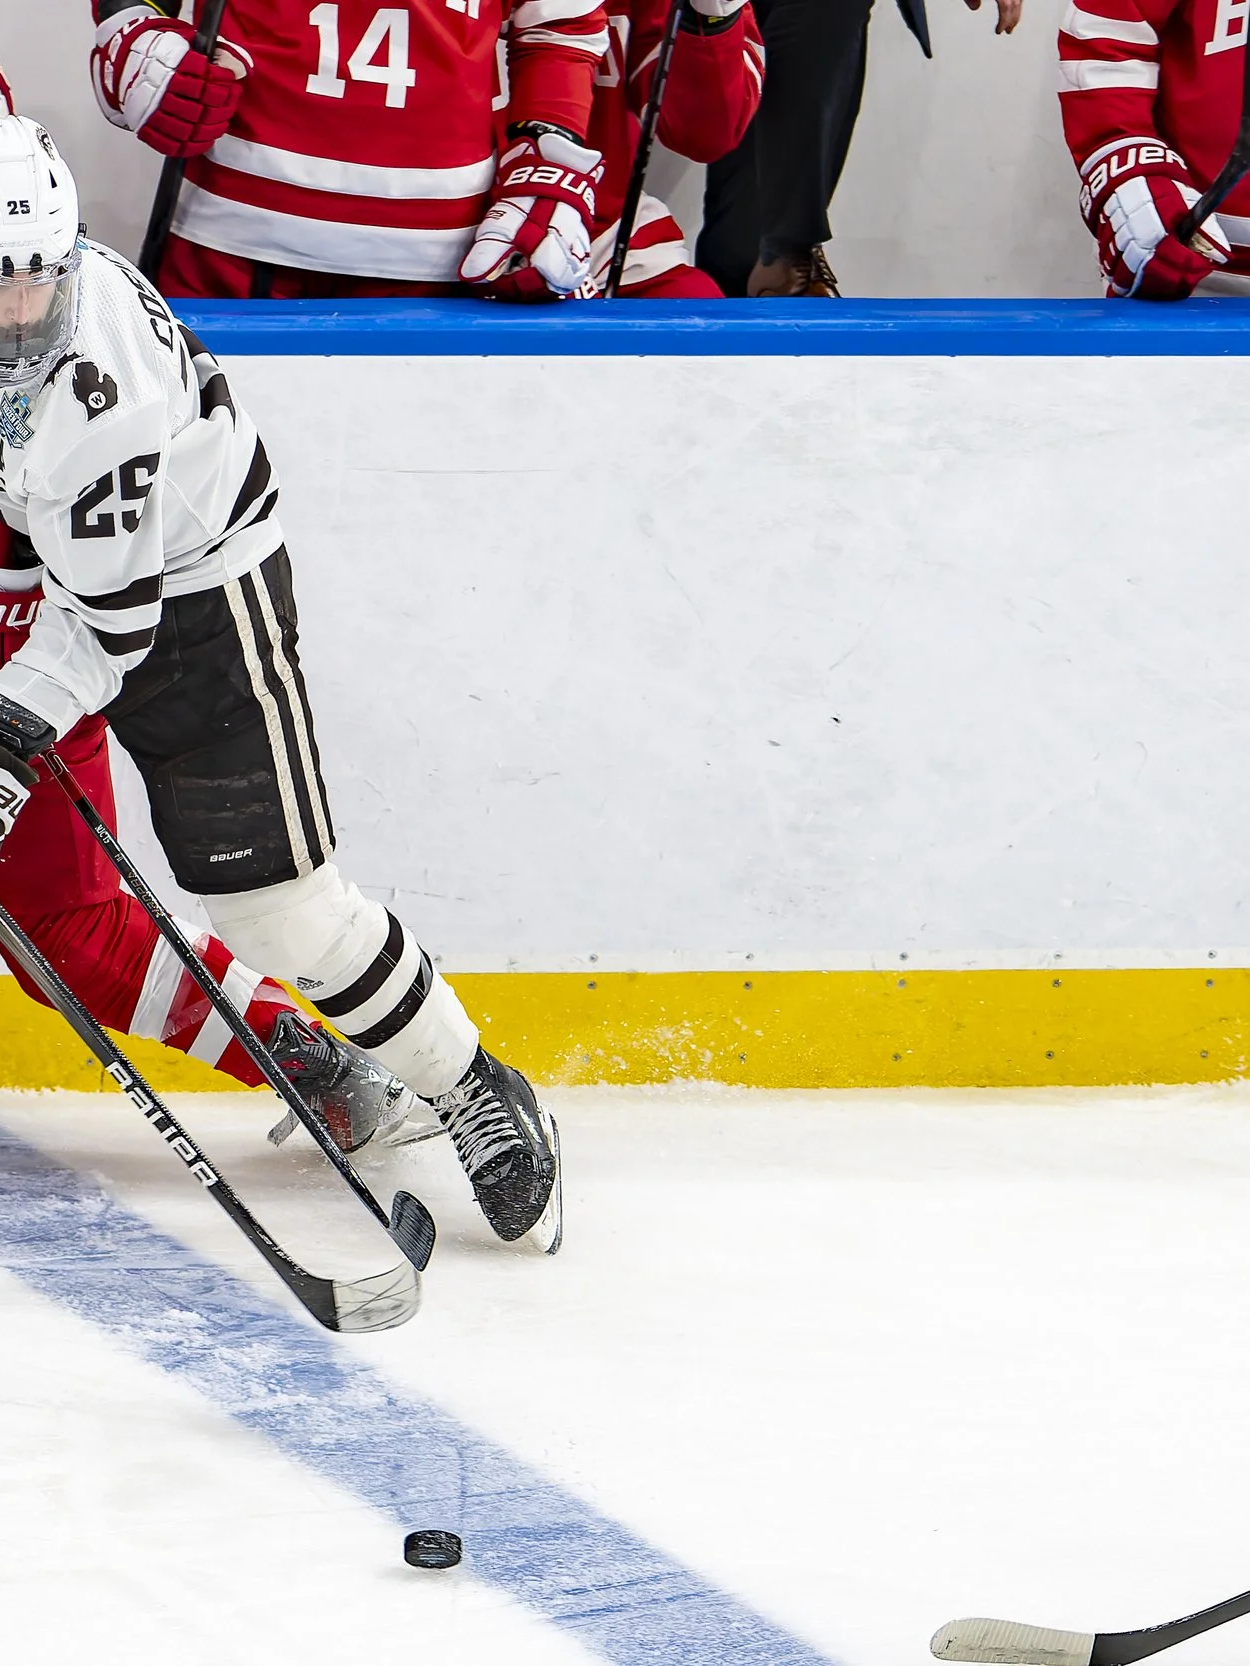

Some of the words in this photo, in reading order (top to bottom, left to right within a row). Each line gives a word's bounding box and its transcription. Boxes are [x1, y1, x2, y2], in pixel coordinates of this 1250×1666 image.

[305, 2, 417, 109] 14
[6, 199, 31, 216] 25
[90, 393, 103, 405] W
[71, 451, 161, 540] 25
